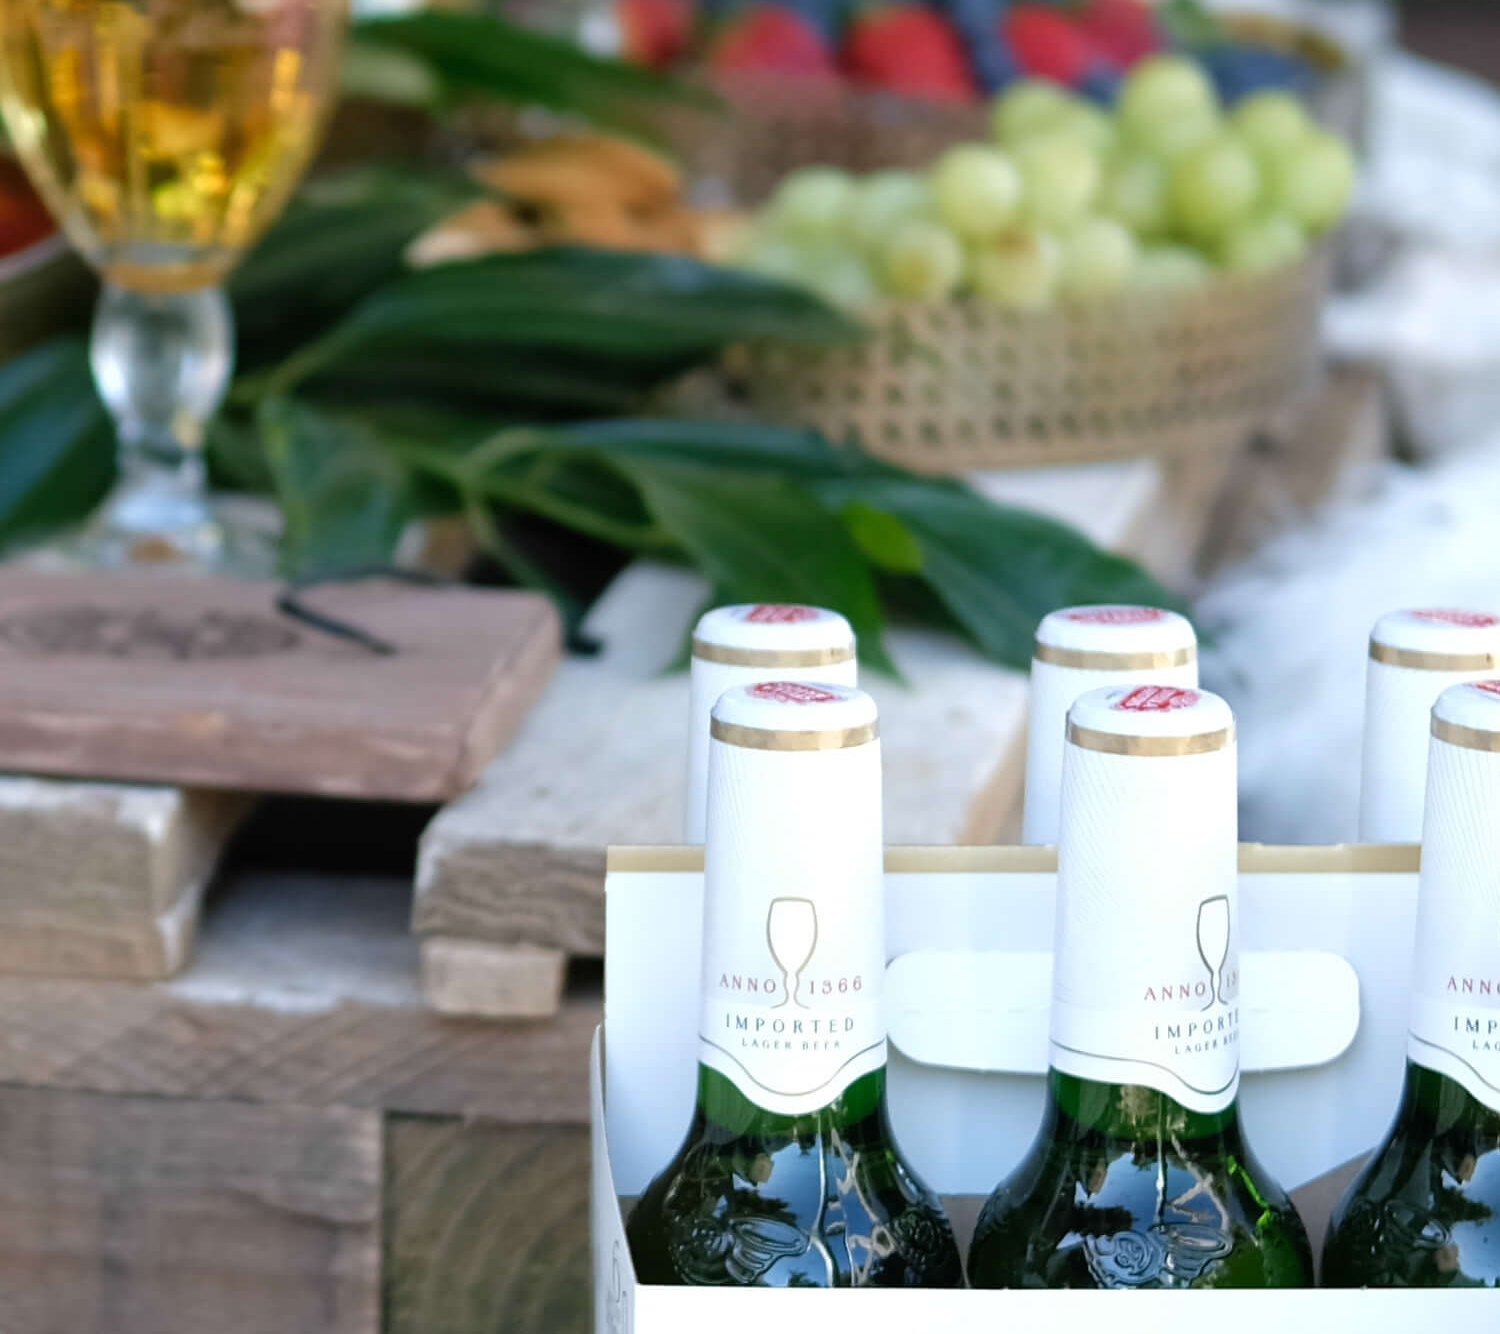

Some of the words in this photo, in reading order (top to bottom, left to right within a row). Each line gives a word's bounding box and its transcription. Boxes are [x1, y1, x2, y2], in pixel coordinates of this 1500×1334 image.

[719, 973, 777, 994] ANNO
[809, 975, 863, 995] 1366
[1144, 981, 1206, 1001] ANNO
[726, 1013, 854, 1034] IMPORTED
[1155, 1007, 1240, 1040] IMPORTE
